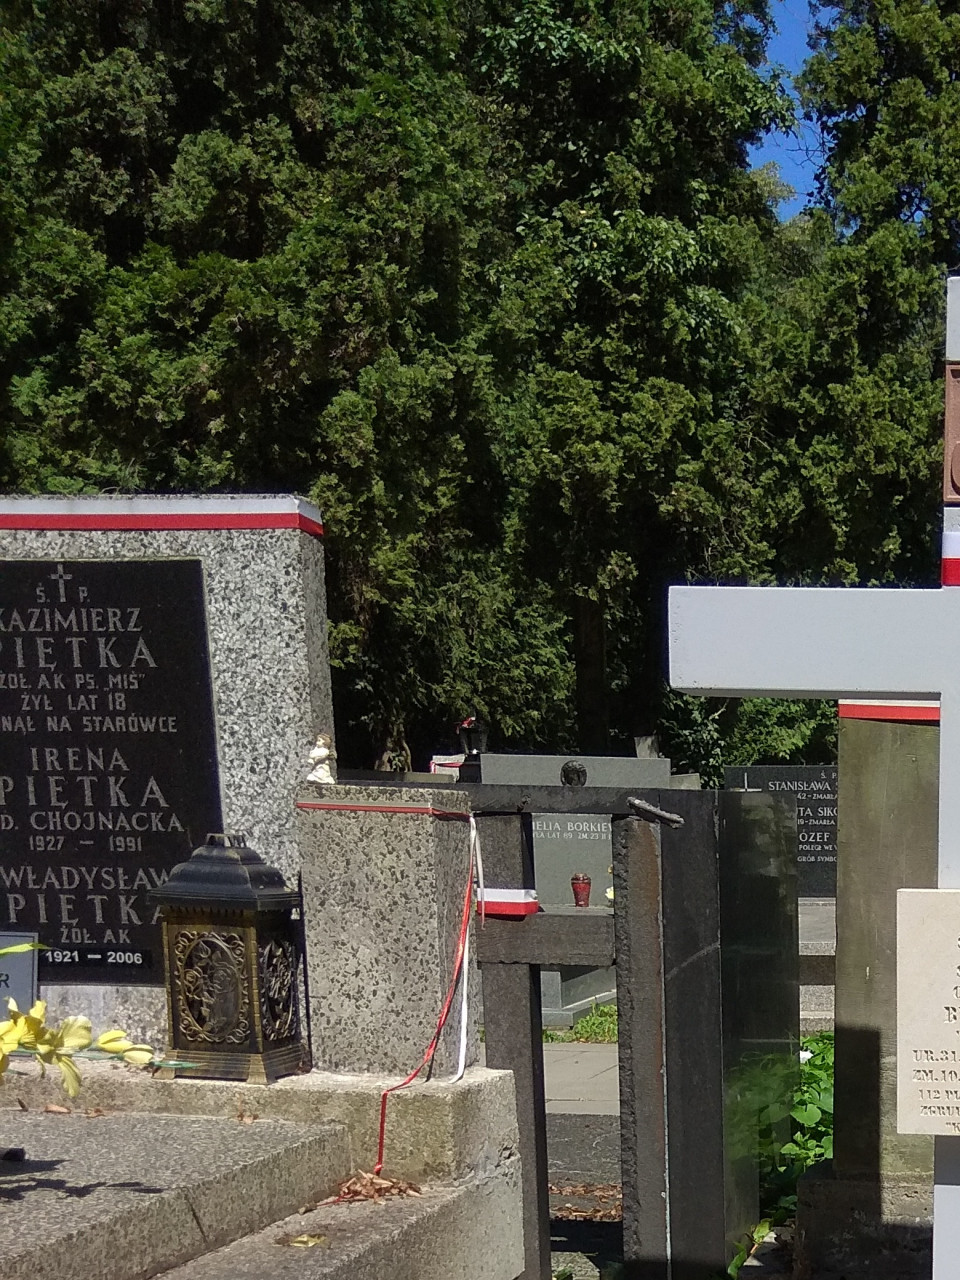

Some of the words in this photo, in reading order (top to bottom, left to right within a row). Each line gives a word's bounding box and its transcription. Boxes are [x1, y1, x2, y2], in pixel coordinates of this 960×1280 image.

[0, 636, 158, 672] IĘTKA
[37, 673, 66, 689] AK
[75, 673, 99, 690] PS.
[67, 694, 98, 711] LAT
[108, 692, 126, 711] 18
[47, 715, 72, 732] NA
[82, 712, 178, 733] STARÓWCE
[30, 747, 130, 771] IRENA
[768, 781, 831, 791] STANISŁAWA
[30, 811, 185, 832] CHOJNACKA
[29, 835, 65, 851] 1927
[109, 835, 143, 852] 1991
[103, 929, 131, 944] AK
[45, 950, 80, 963] 1921
[107, 951, 143, 965] 2006
